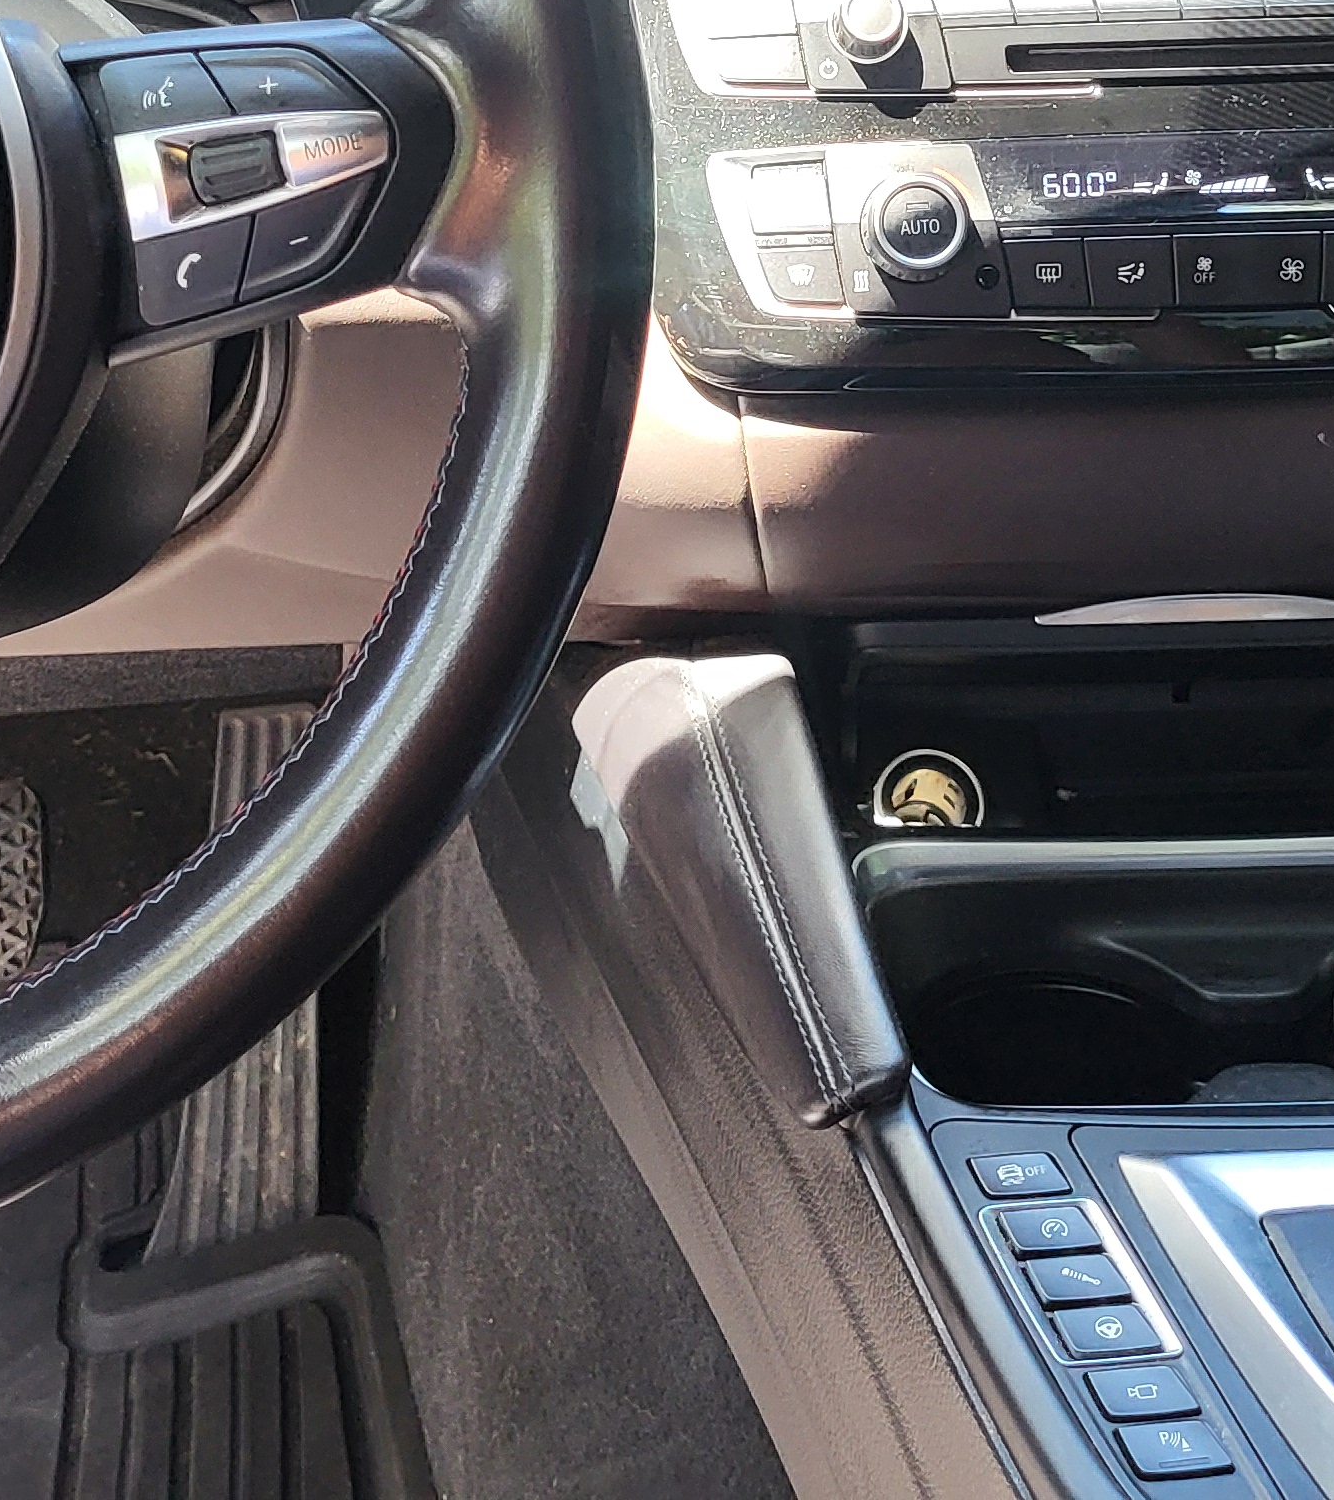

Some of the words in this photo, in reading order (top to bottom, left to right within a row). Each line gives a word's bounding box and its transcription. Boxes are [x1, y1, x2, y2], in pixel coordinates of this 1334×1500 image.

[303, 134, 364, 162] MODE
[900, 219, 941, 236] AUTO
[1193, 271, 1216, 284] OFF
[1025, 1164, 1046, 1177] OFF
